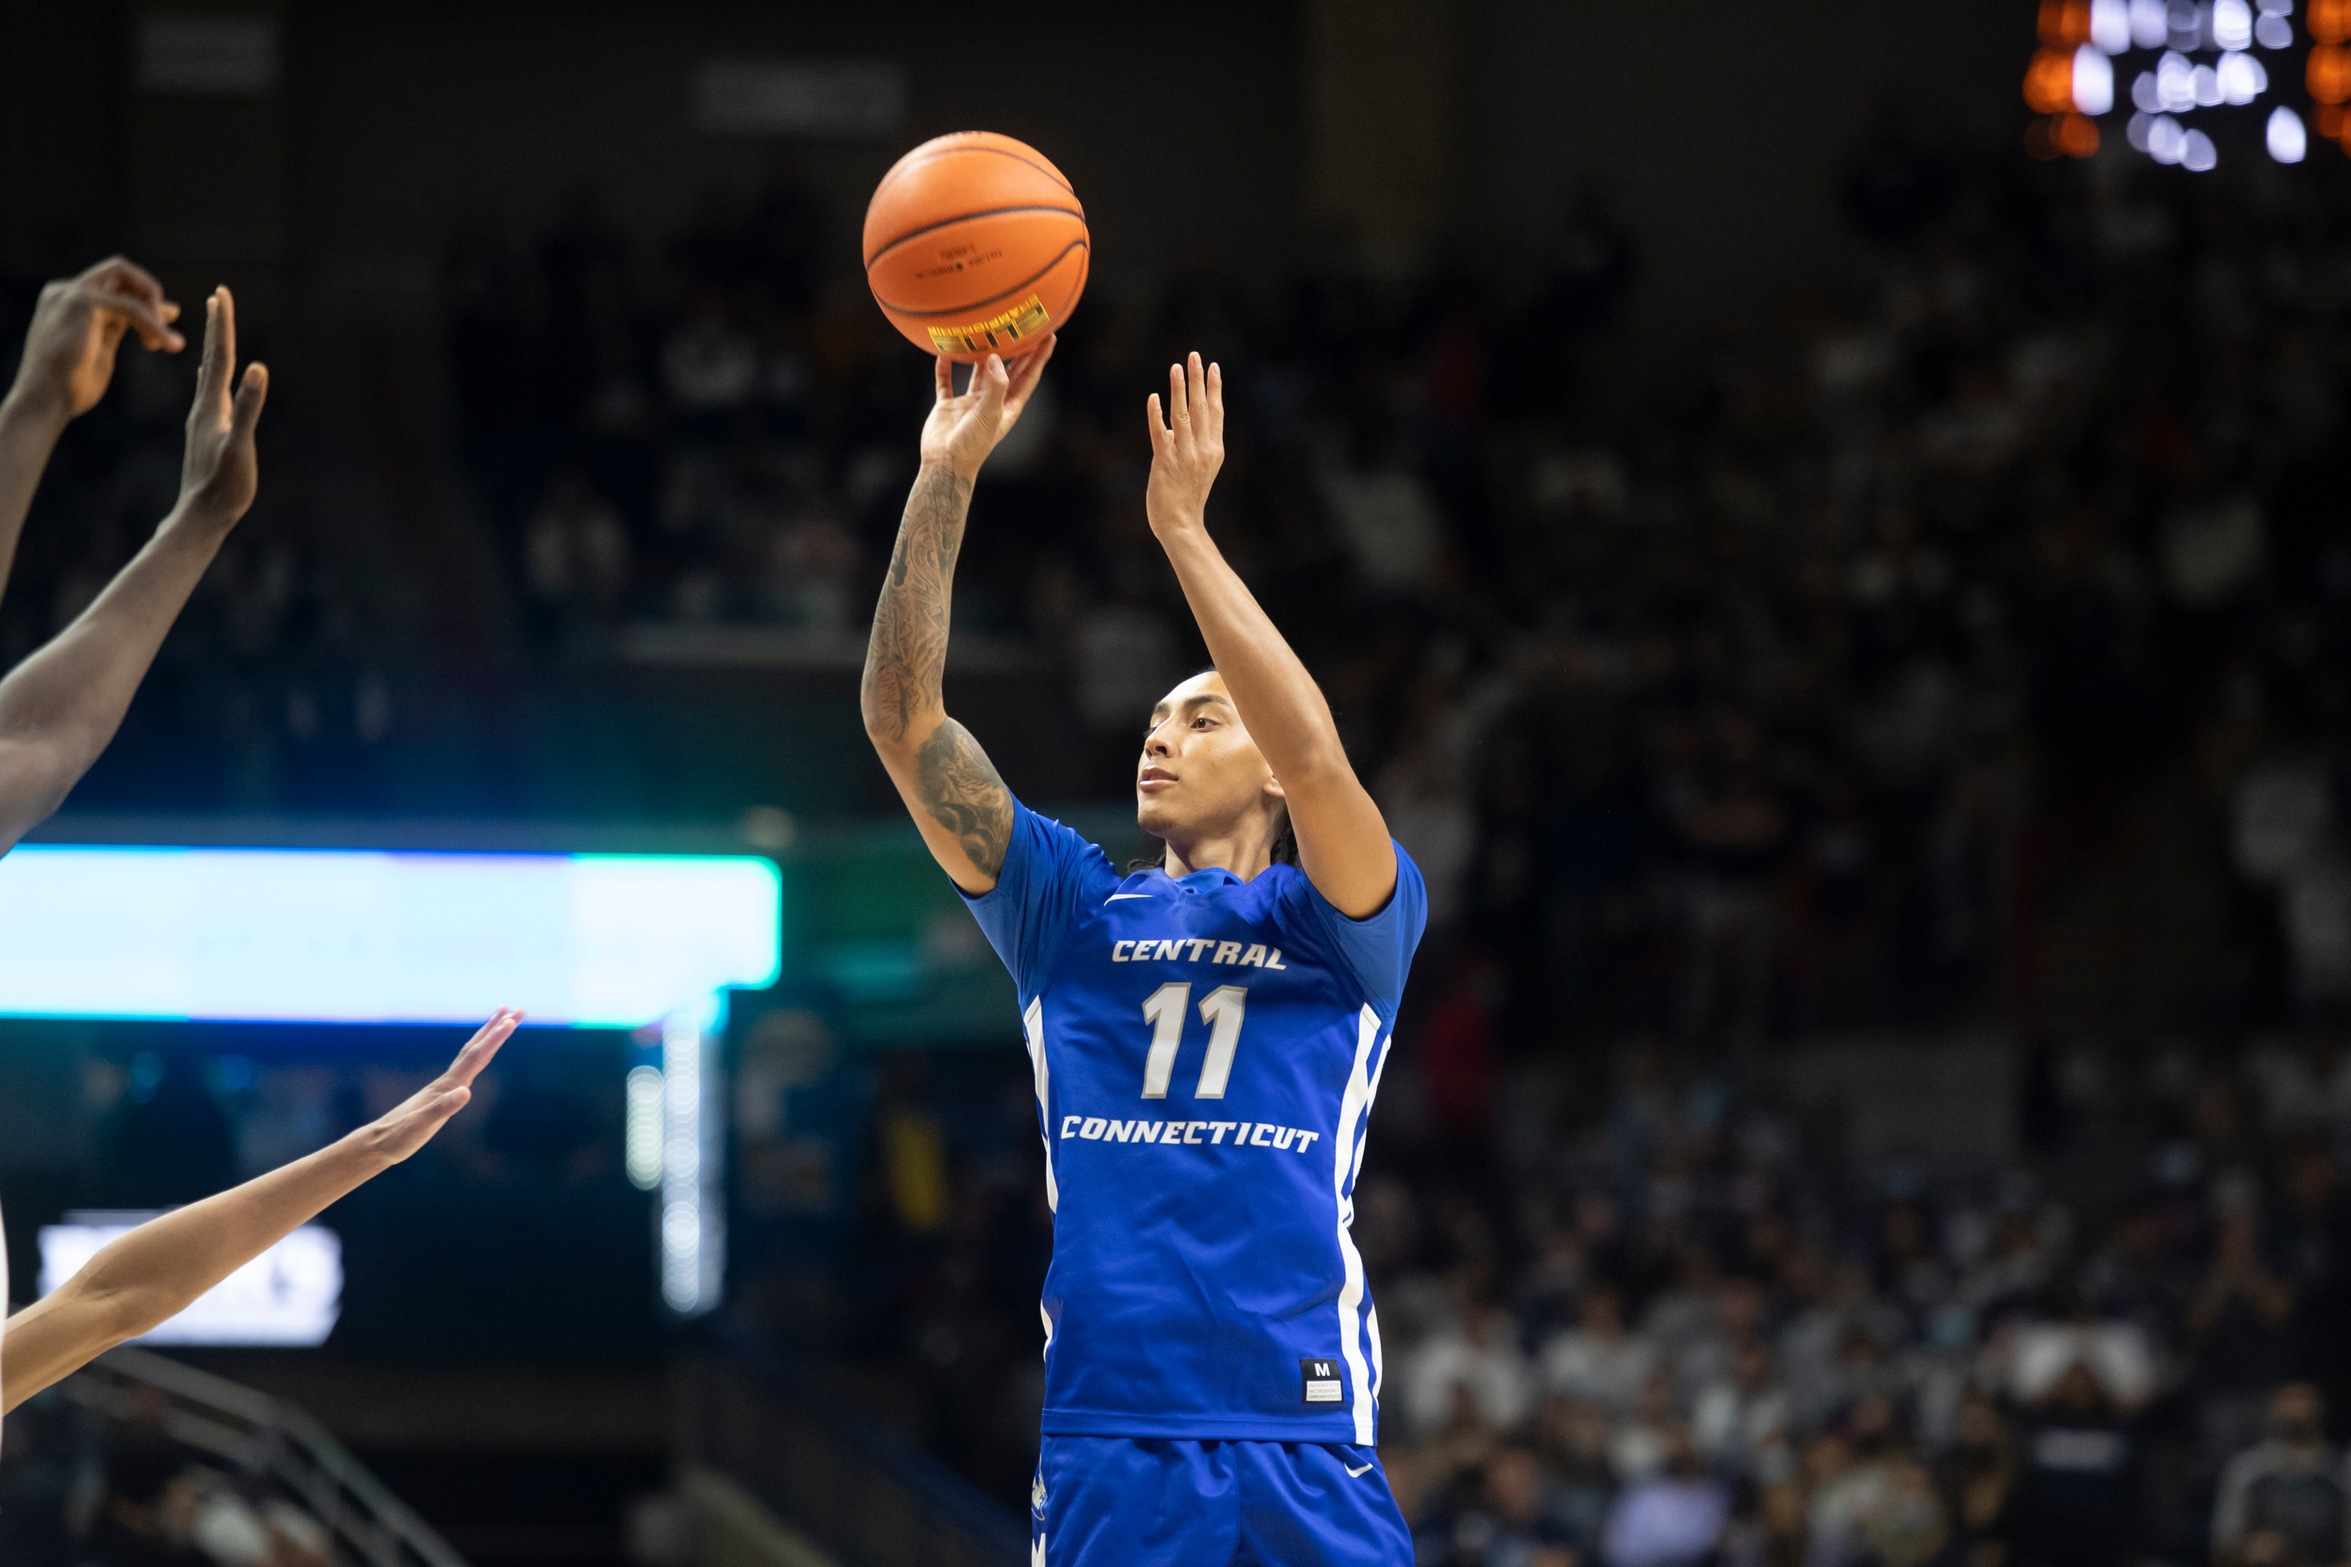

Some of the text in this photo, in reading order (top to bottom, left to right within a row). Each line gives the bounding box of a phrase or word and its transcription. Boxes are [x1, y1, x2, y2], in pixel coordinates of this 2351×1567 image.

[1112, 938, 1287, 971] CENTRAL
[1141, 981, 1248, 1100] 11
[1060, 1115, 1319, 1154] CONNECTICUT
[1314, 1362, 1331, 1377] M
